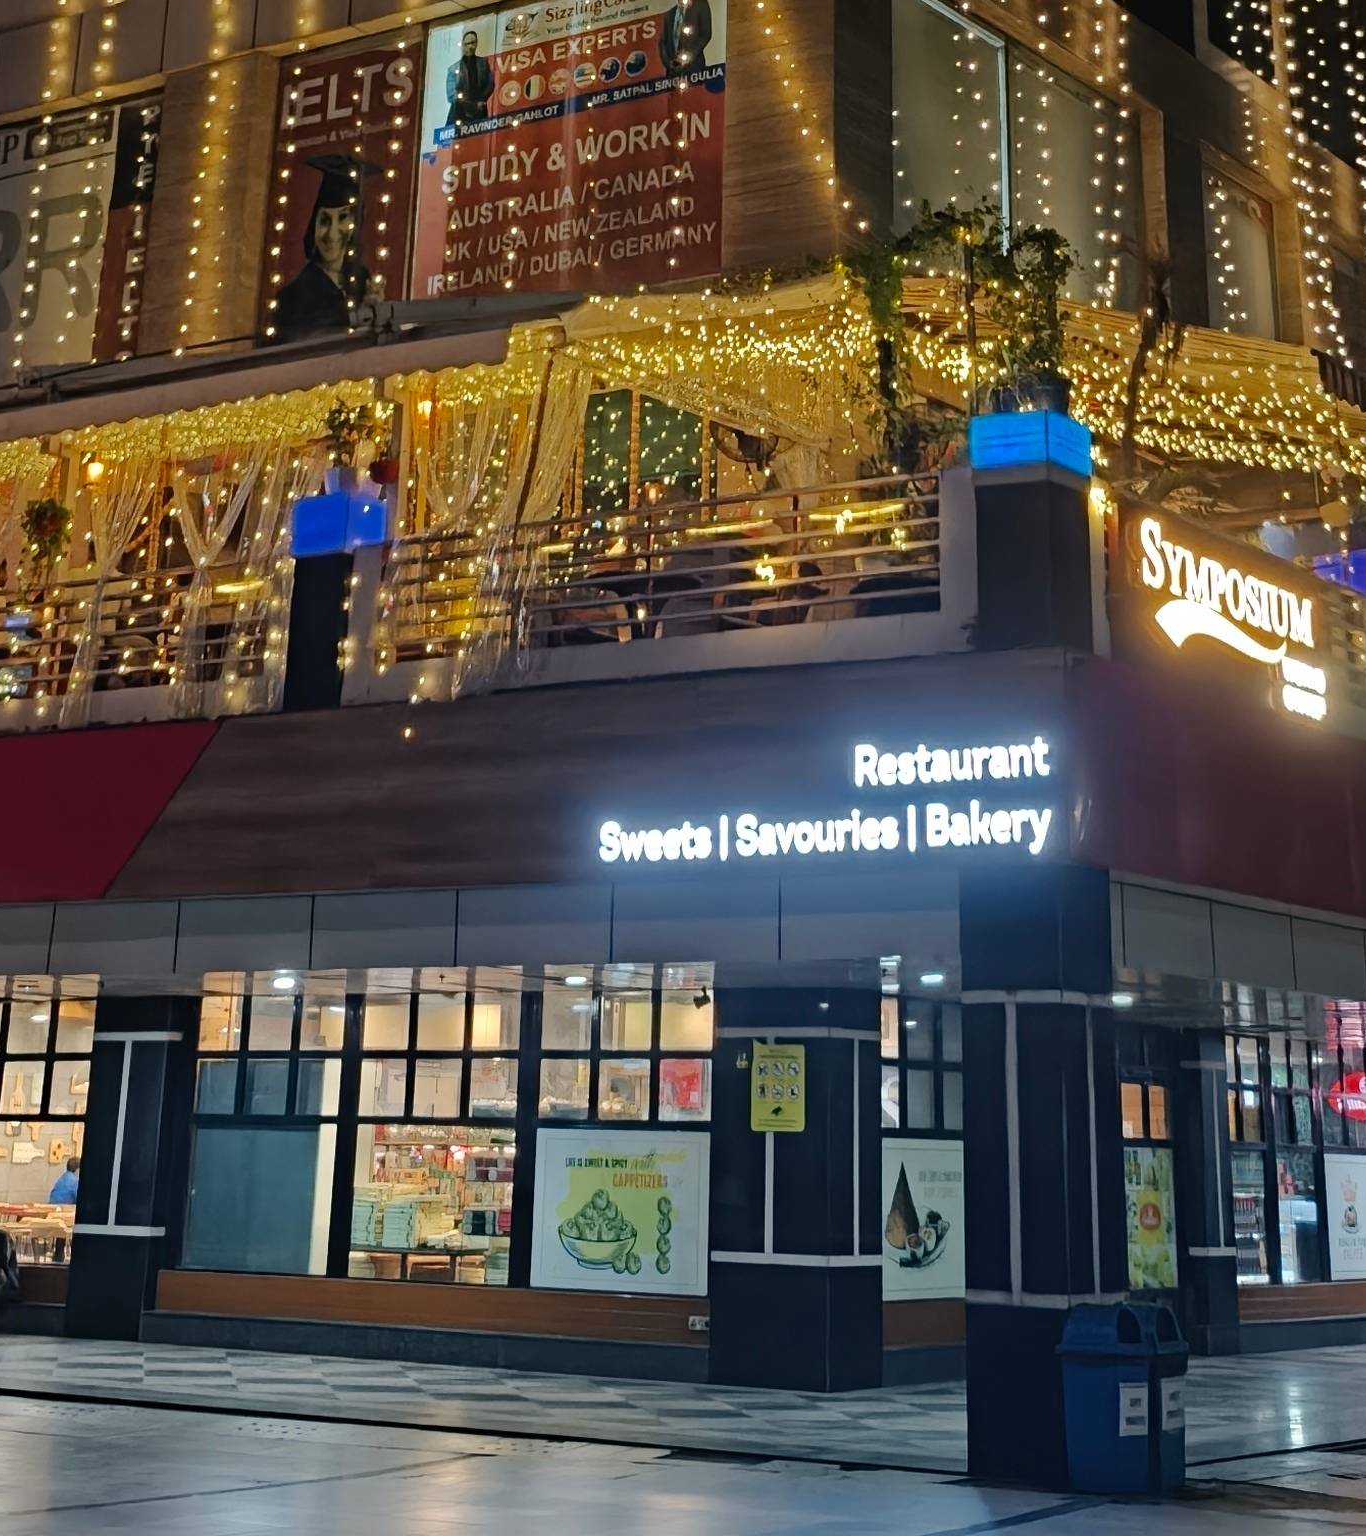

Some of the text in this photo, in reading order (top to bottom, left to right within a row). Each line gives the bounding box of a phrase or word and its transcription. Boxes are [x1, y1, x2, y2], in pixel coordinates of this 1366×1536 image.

[496, 20, 656, 74] VISA EXPERTS
[691, 68, 723, 84] GULIA
[281, 58, 413, 130] IELTS
[439, 129, 458, 142] MR.
[460, 117, 514, 136] RAVINDER
[442, 110, 710, 194] STUDY & WORK IN
[447, 185, 574, 232] AUSTRALIA
[594, 161, 694, 200] CANADA
[427, 262, 513, 296] IRELAND
[530, 248, 592, 277] DUBAI
[610, 222, 717, 260] GERMANY
[444, 241, 471, 264] UK
[488, 230, 528, 255] USA
[545, 218, 590, 244] NEW
[596, 197, 695, 234] ZEALAND
[855, 736, 1051, 786] Restaurant
[599, 820, 711, 862] Sweets
[735, 808, 899, 858] Savouries
[925, 800, 1051, 855] Bakery
